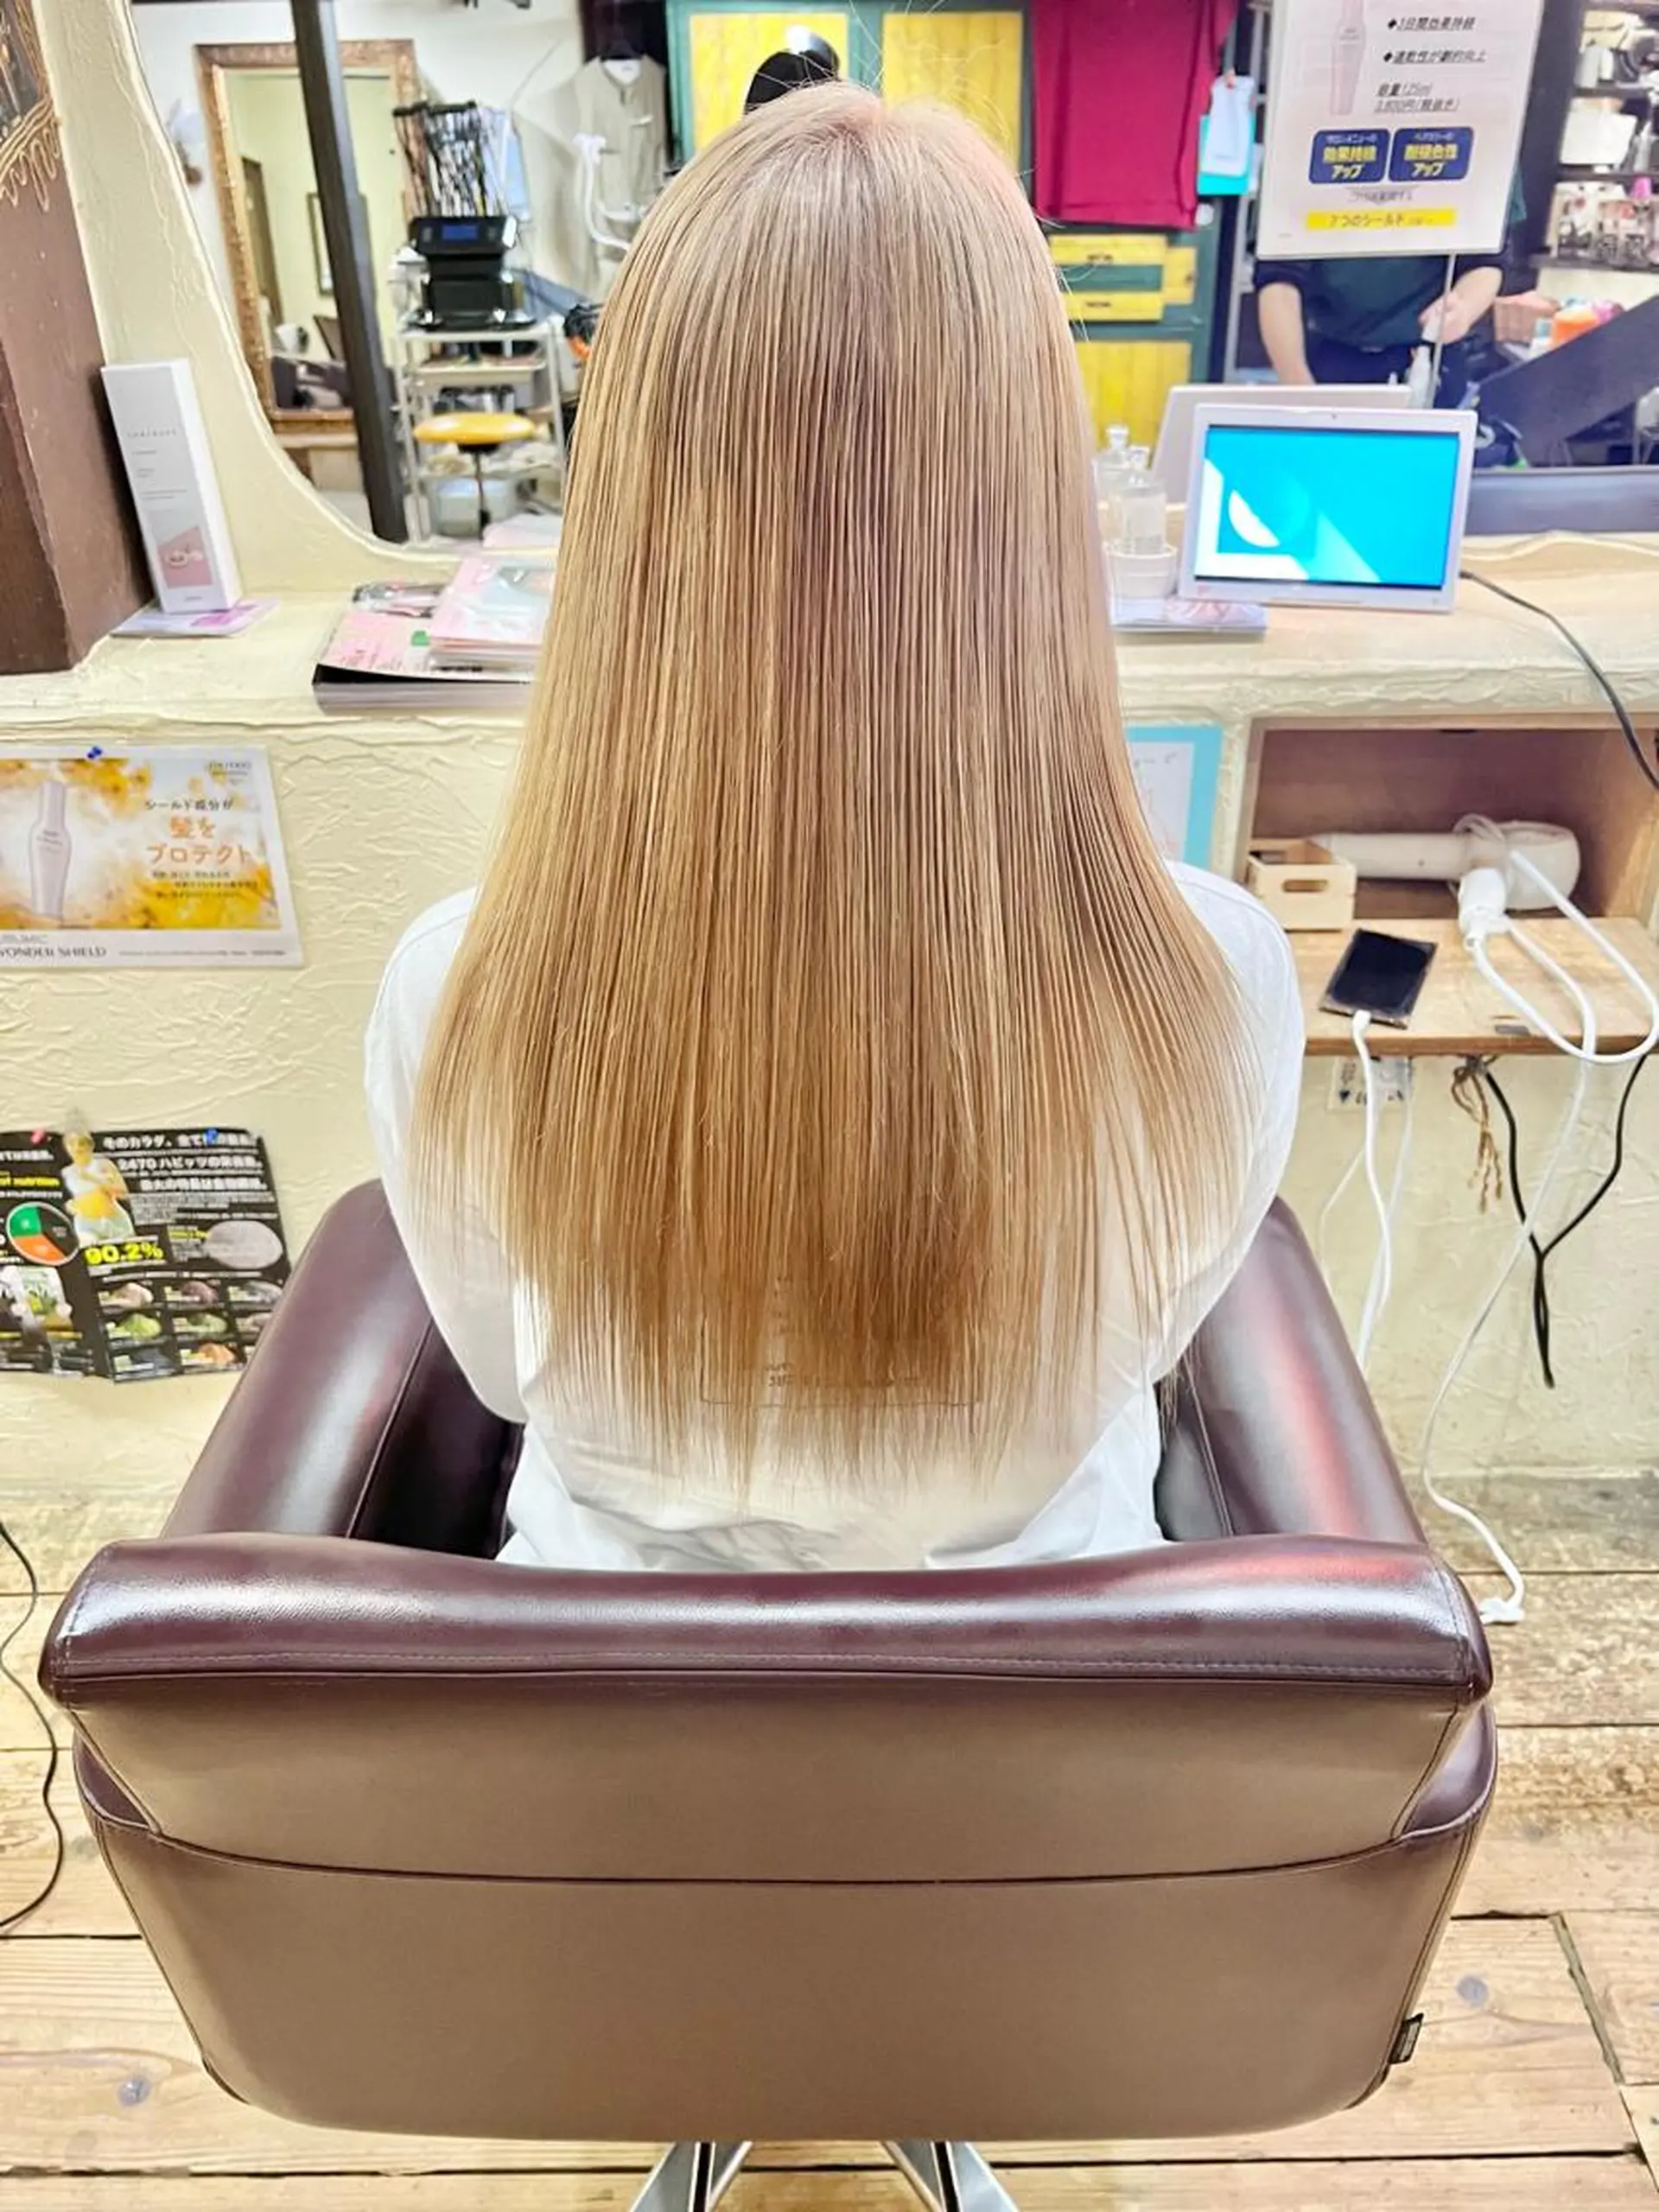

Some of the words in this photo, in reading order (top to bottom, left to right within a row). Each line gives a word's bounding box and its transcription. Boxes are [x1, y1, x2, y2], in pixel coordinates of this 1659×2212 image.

[1331, 164, 1365, 179] アップ
[1411, 162, 1447, 177] アップ
[170, 816, 216, 839] 髪を
[147, 842, 251, 864] プロテクト
[85, 1242, 164, 1265] 90.2%
